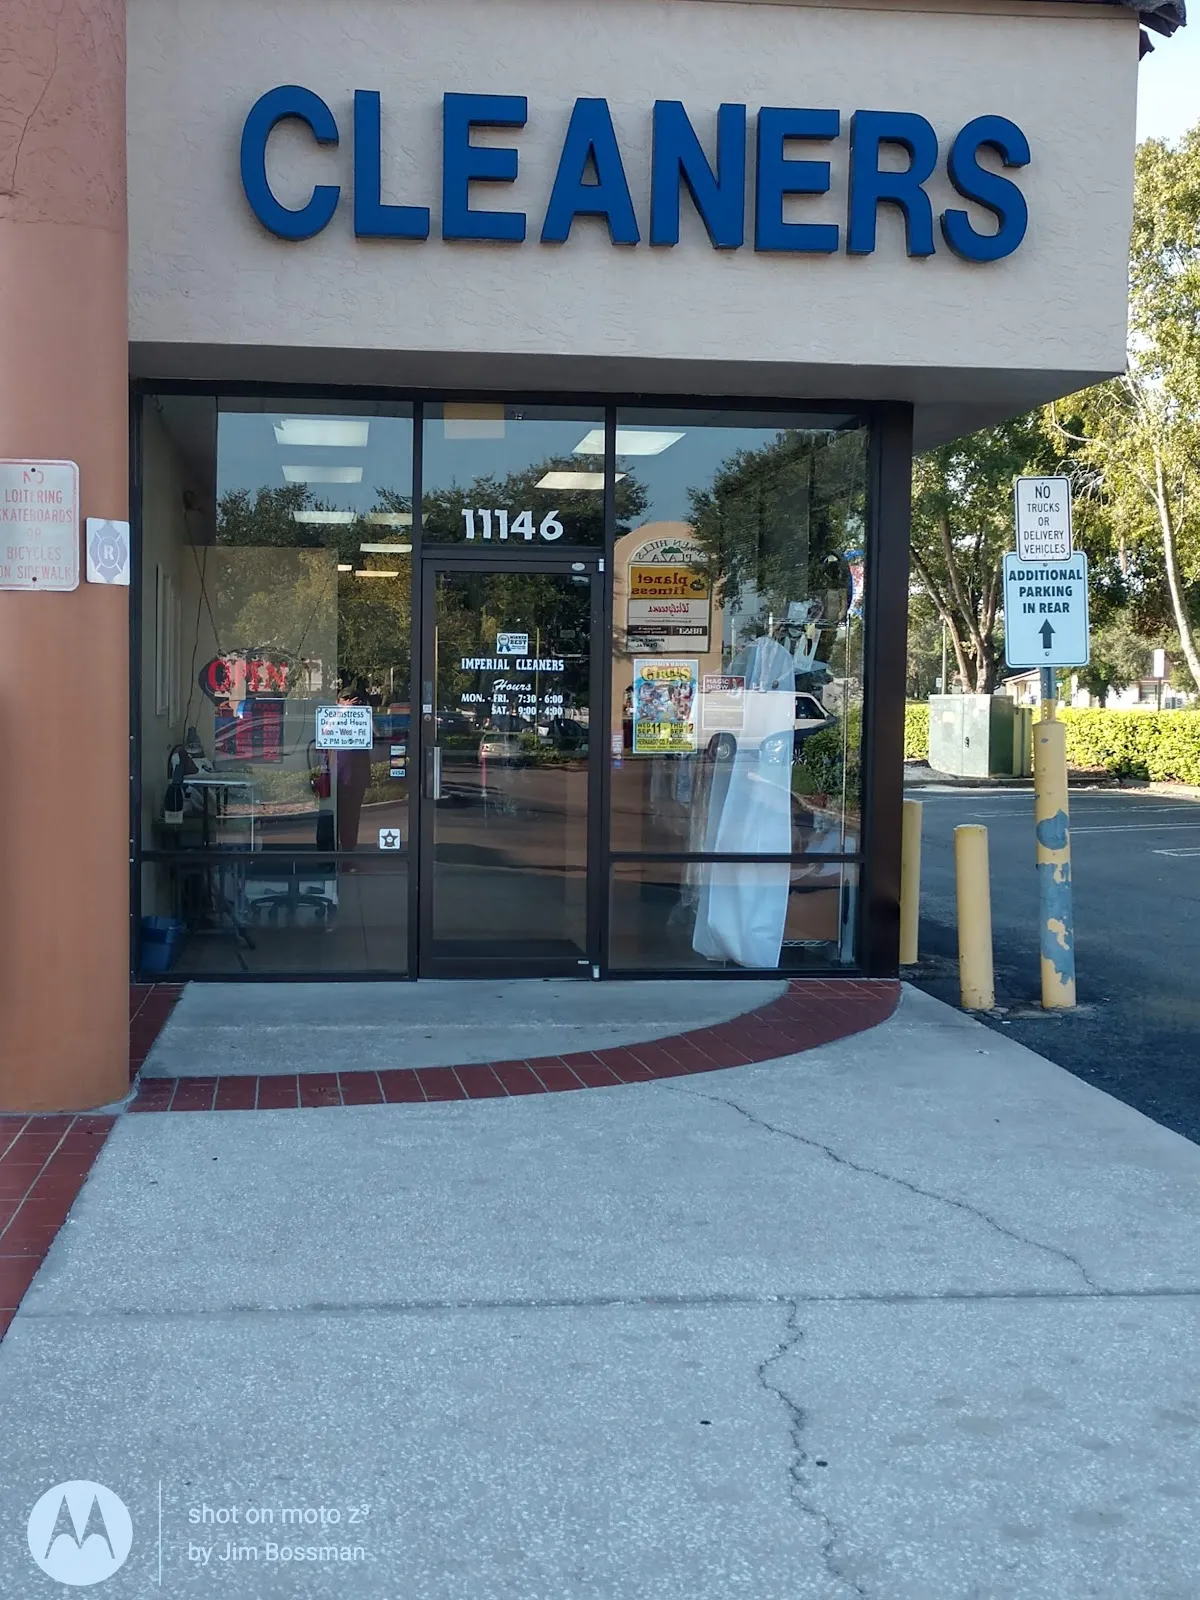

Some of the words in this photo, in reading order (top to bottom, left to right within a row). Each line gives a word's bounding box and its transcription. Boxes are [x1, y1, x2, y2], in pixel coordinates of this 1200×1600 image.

[239, 84, 1032, 263] CLEANERS
[5, 488, 63, 504] LOITERING
[1035, 485, 1051, 499] NO
[1027, 502, 1060, 513] TRUCKS
[461, 508, 564, 541] 11146
[1038, 517, 1050, 527] OR
[1024, 530, 1064, 540] DELIVERY
[103, 544, 115, 561] R
[1024, 543, 1066, 554] VEHICLES
[1008, 569, 1083, 581] ADDITIONAL
[1019, 585, 1073, 597] PARKING
[1023, 602, 1036, 614] IN
[1039, 602, 1070, 613] REAR
[461, 657, 509, 670] IMPERIAL
[515, 658, 565, 672] CLEANERS
[208, 659, 288, 692] OPEN
[492, 679, 532, 692] Hours
[461, 693, 486, 703] MON.
[493, 693, 509, 703] FRI.
[518, 694, 536, 703] 7:30
[544, 694, 564, 704] 6:00
[324, 708, 364, 718] Seamstress
[491, 705, 509, 715] SAT.
[518, 705, 536, 715] 9:00
[544, 706, 563, 715] 4:00
[339, 728, 352, 736] Wed
[358, 728, 366, 736] Fri
[651, 723, 661, 734] 11
